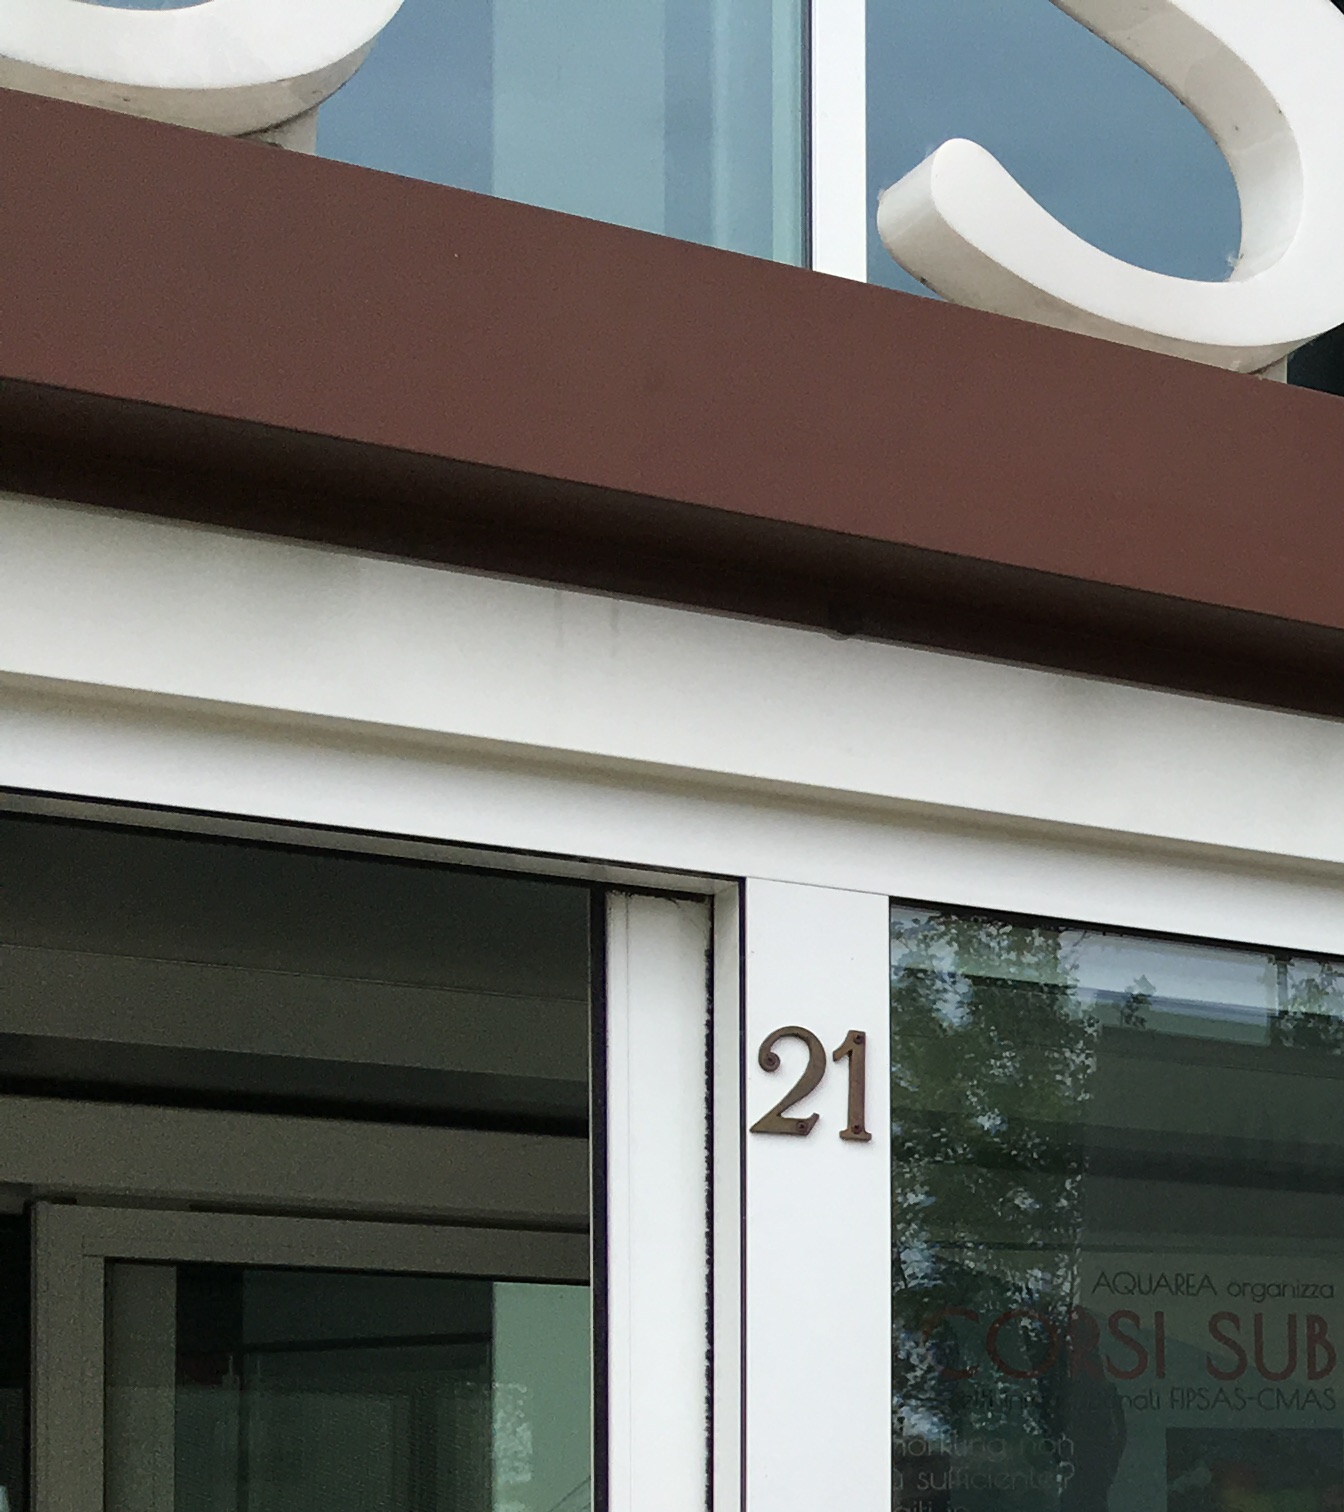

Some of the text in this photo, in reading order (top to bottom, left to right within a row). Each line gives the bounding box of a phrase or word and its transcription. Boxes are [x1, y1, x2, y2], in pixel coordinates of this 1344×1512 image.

[749, 1025, 873, 1143] 21
[1091, 1270, 1336, 1304] AQUAREA organizza
[926, 1306, 1337, 1381] CORSI SUB
[1169, 1386, 1337, 1412] FIPSAS-CMAS
[1019, 1436, 1074, 1458] non
